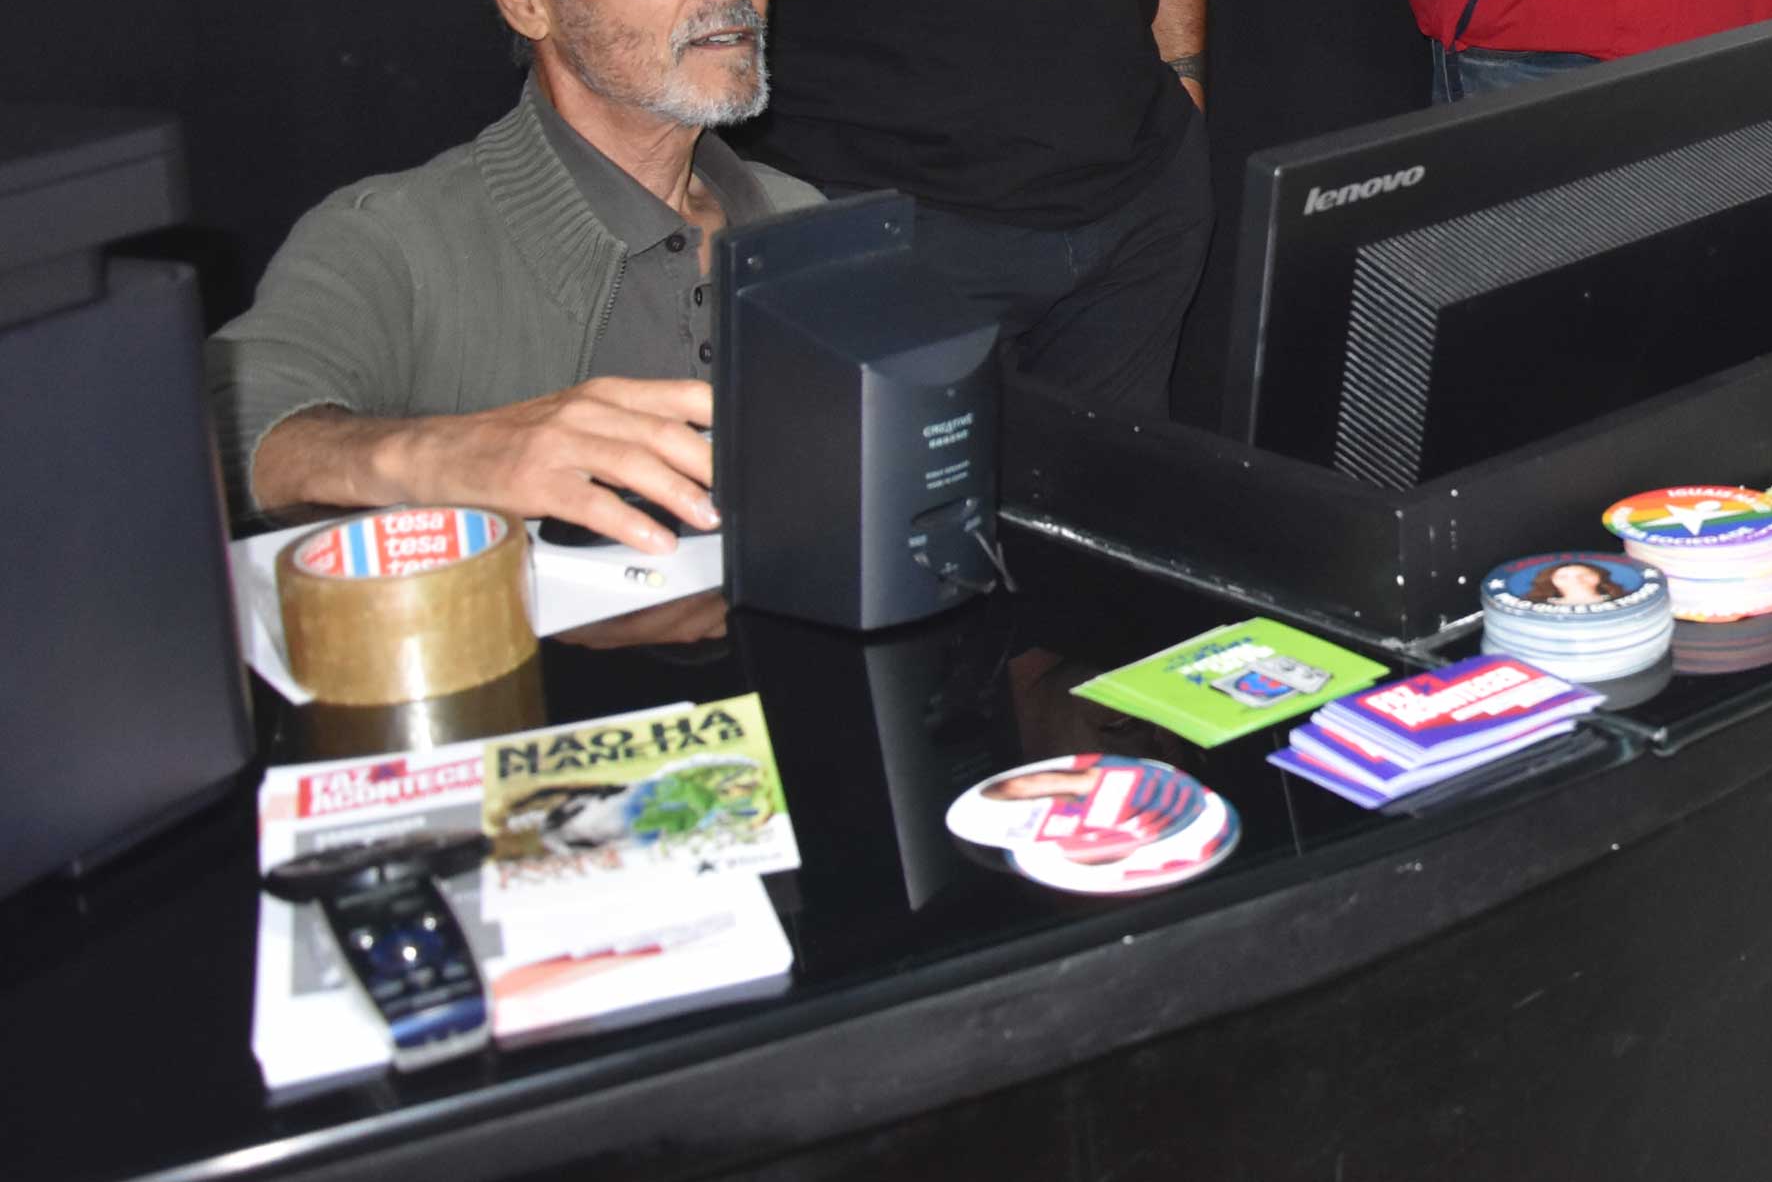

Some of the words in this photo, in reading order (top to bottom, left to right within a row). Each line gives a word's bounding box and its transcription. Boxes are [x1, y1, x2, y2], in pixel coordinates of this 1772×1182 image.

[1303, 165, 1426, 216] lenovo
[382, 512, 444, 534] tesa
[384, 535, 447, 557] tesa
